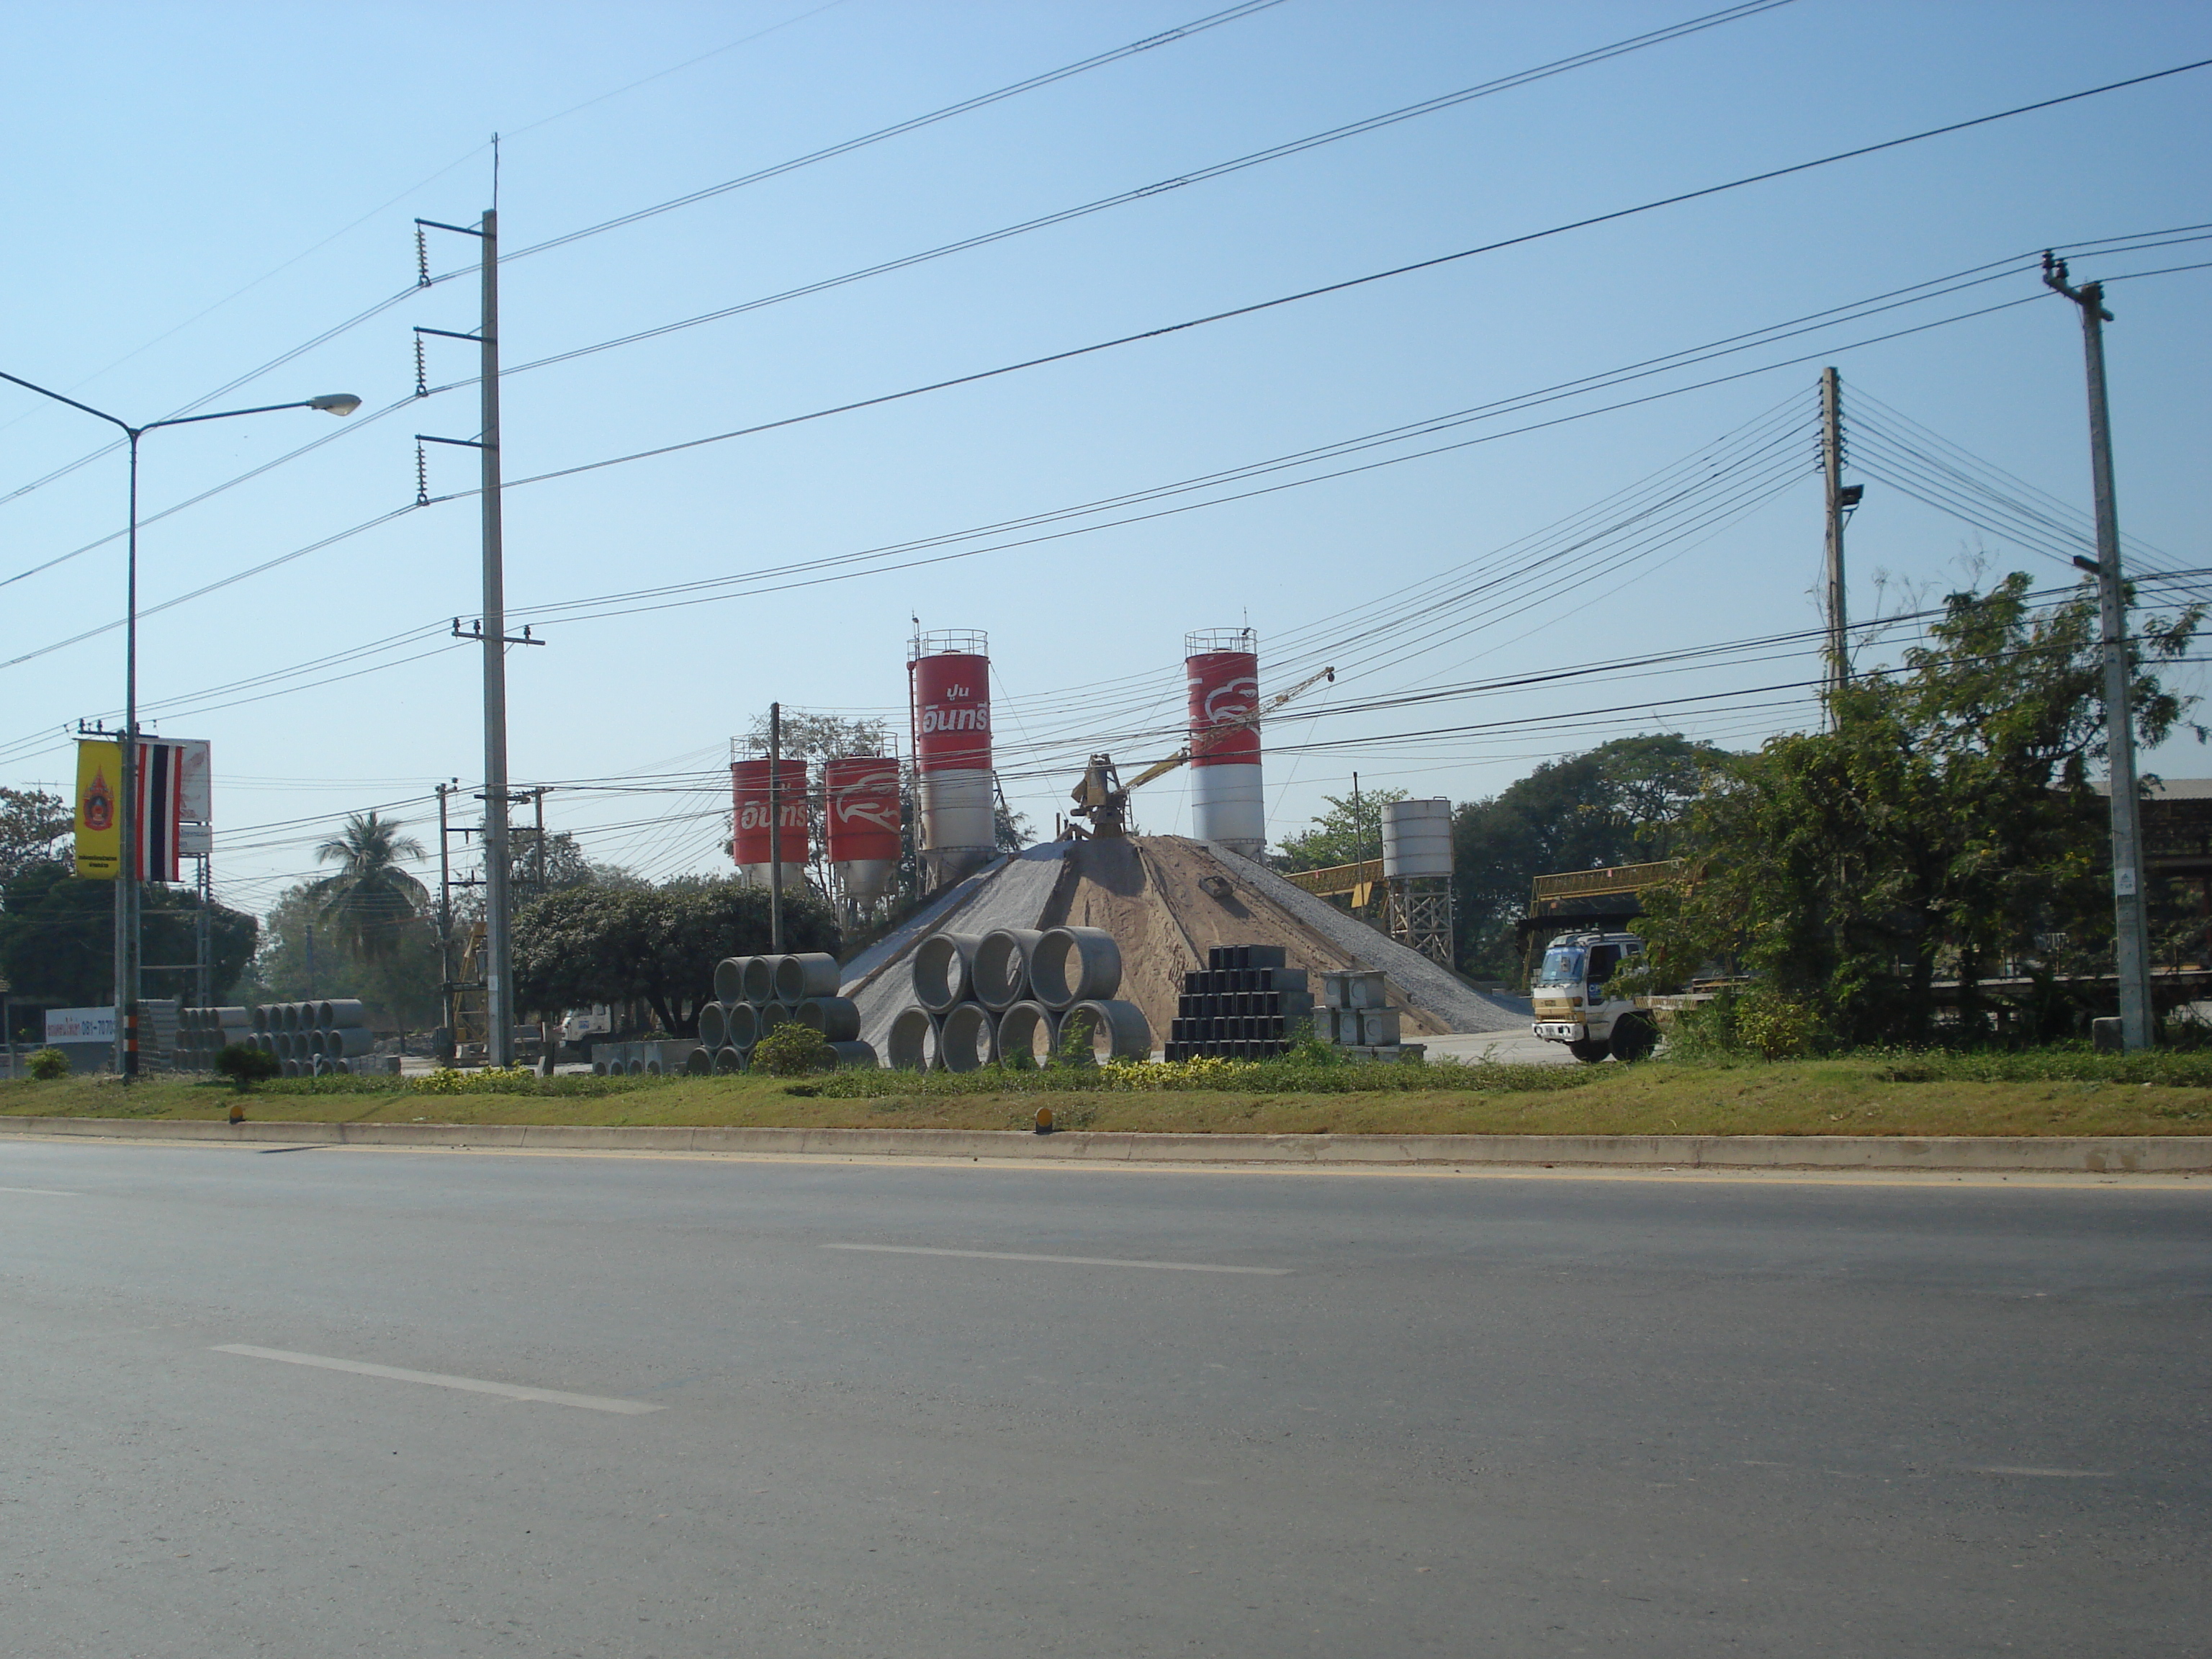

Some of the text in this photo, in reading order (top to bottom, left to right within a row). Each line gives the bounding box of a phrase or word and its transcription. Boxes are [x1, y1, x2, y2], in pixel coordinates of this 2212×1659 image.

[947, 682, 970, 701] ปูน
[922, 701, 987, 733] อินทรี
[81, 1020, 115, 1035] 081-7070
